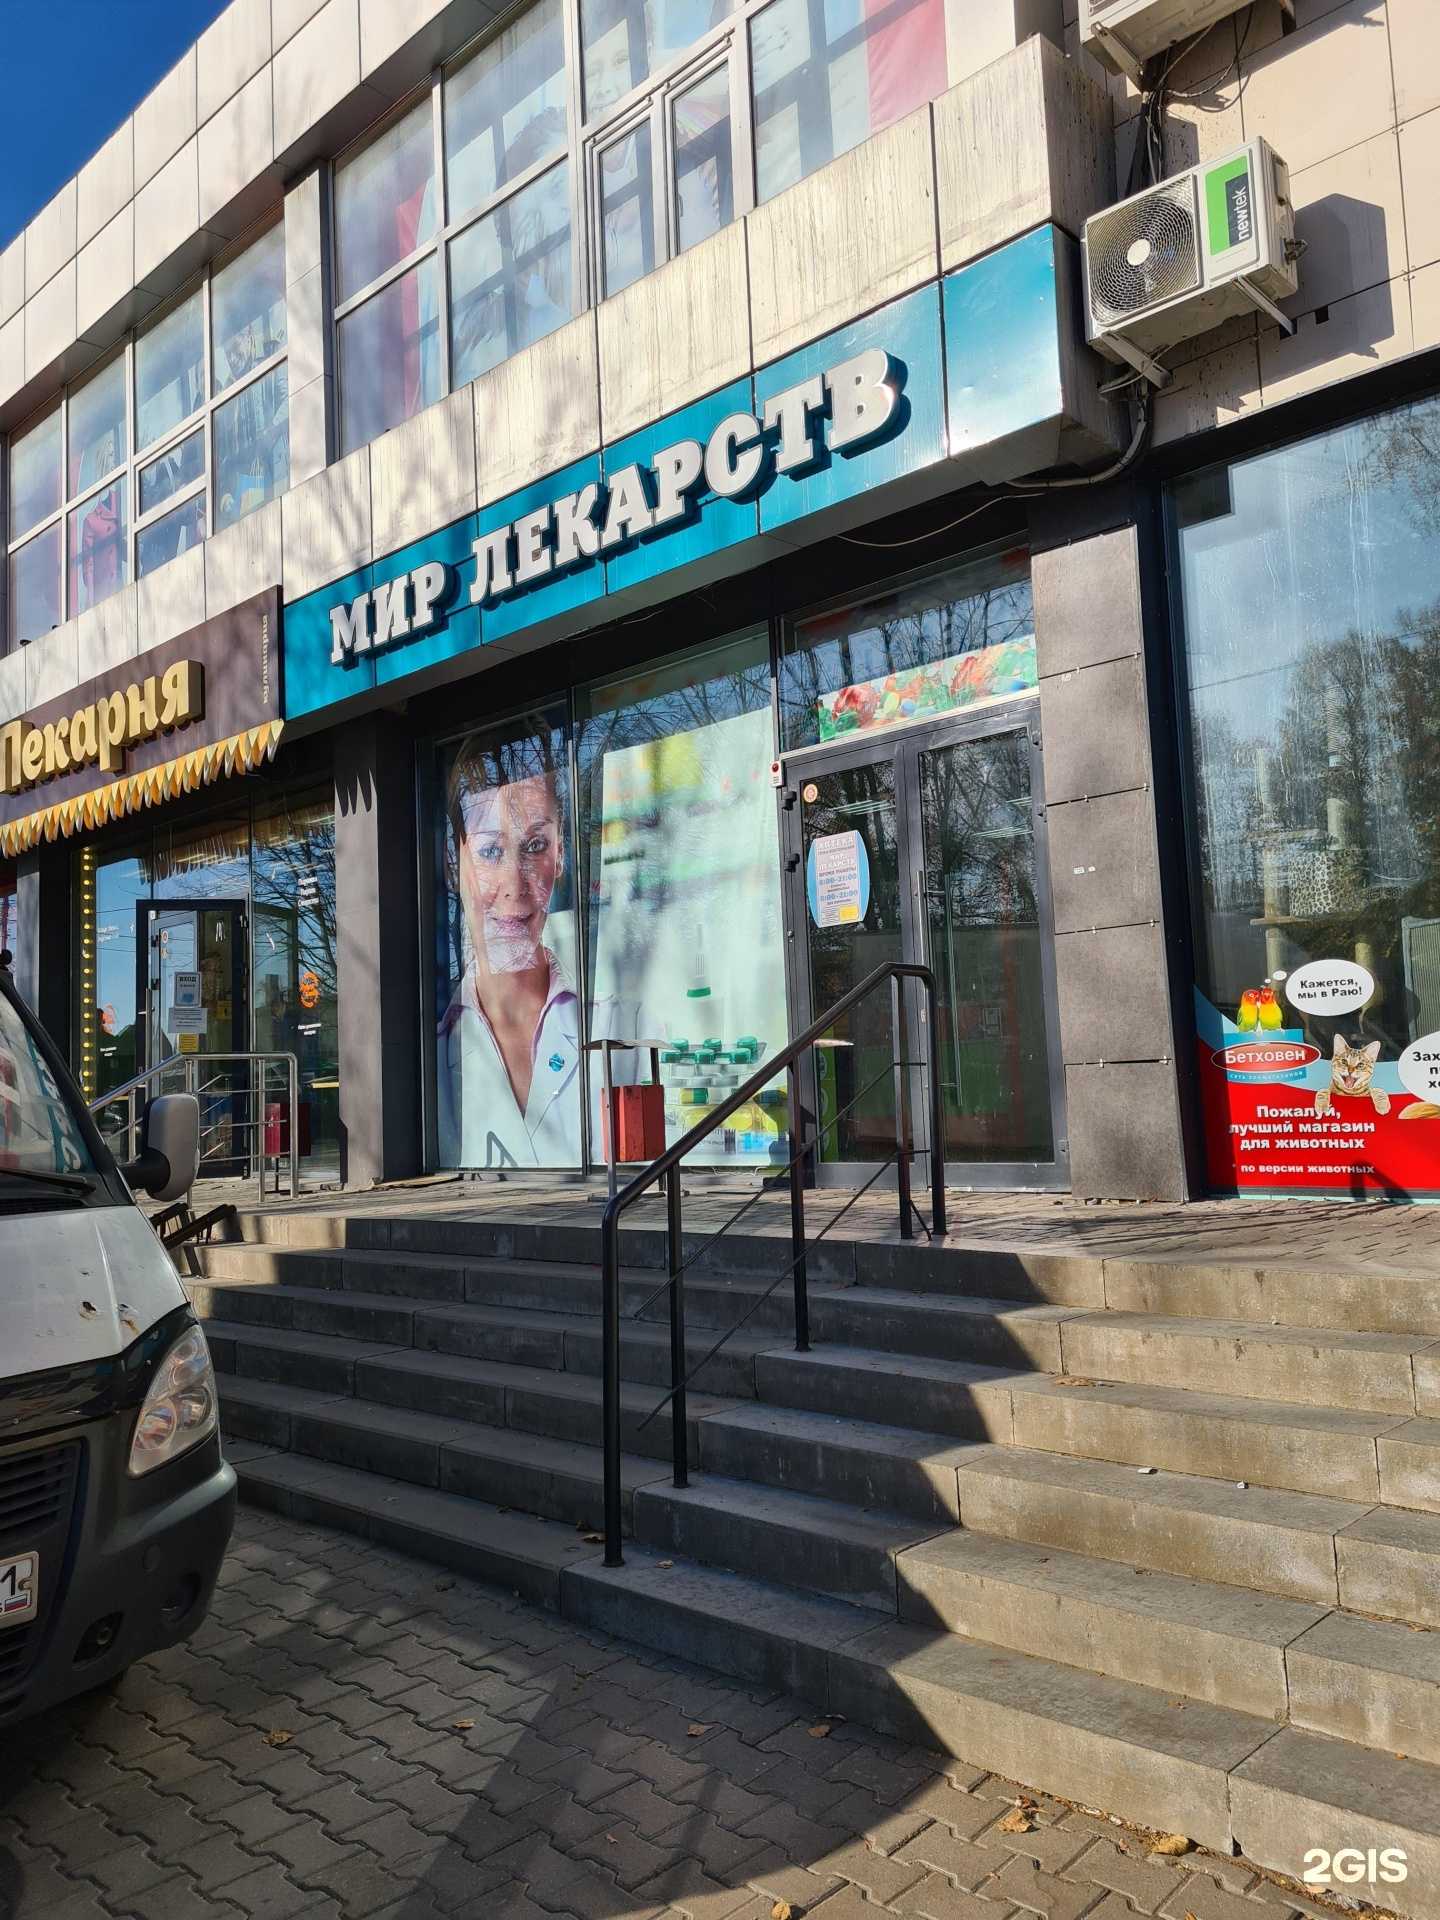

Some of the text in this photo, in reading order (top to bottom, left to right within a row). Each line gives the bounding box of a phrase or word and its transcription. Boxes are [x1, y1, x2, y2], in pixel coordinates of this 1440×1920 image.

[1232, 186, 1250, 242] newtek
[329, 348, 899, 666] МИР ЛЕКАРСТВ
[0, 659, 191, 793] Пекарня
[1300, 979, 1358, 989] Кажется,
[1332, 987, 1362, 997] Раю!
[1225, 1050, 1306, 1064] Бетховен
[1229, 1121, 1375, 1136] лучший магазин
[1240, 1138, 1366, 1150] для животных
[1241, 1164, 1375, 1174] по версии животных
